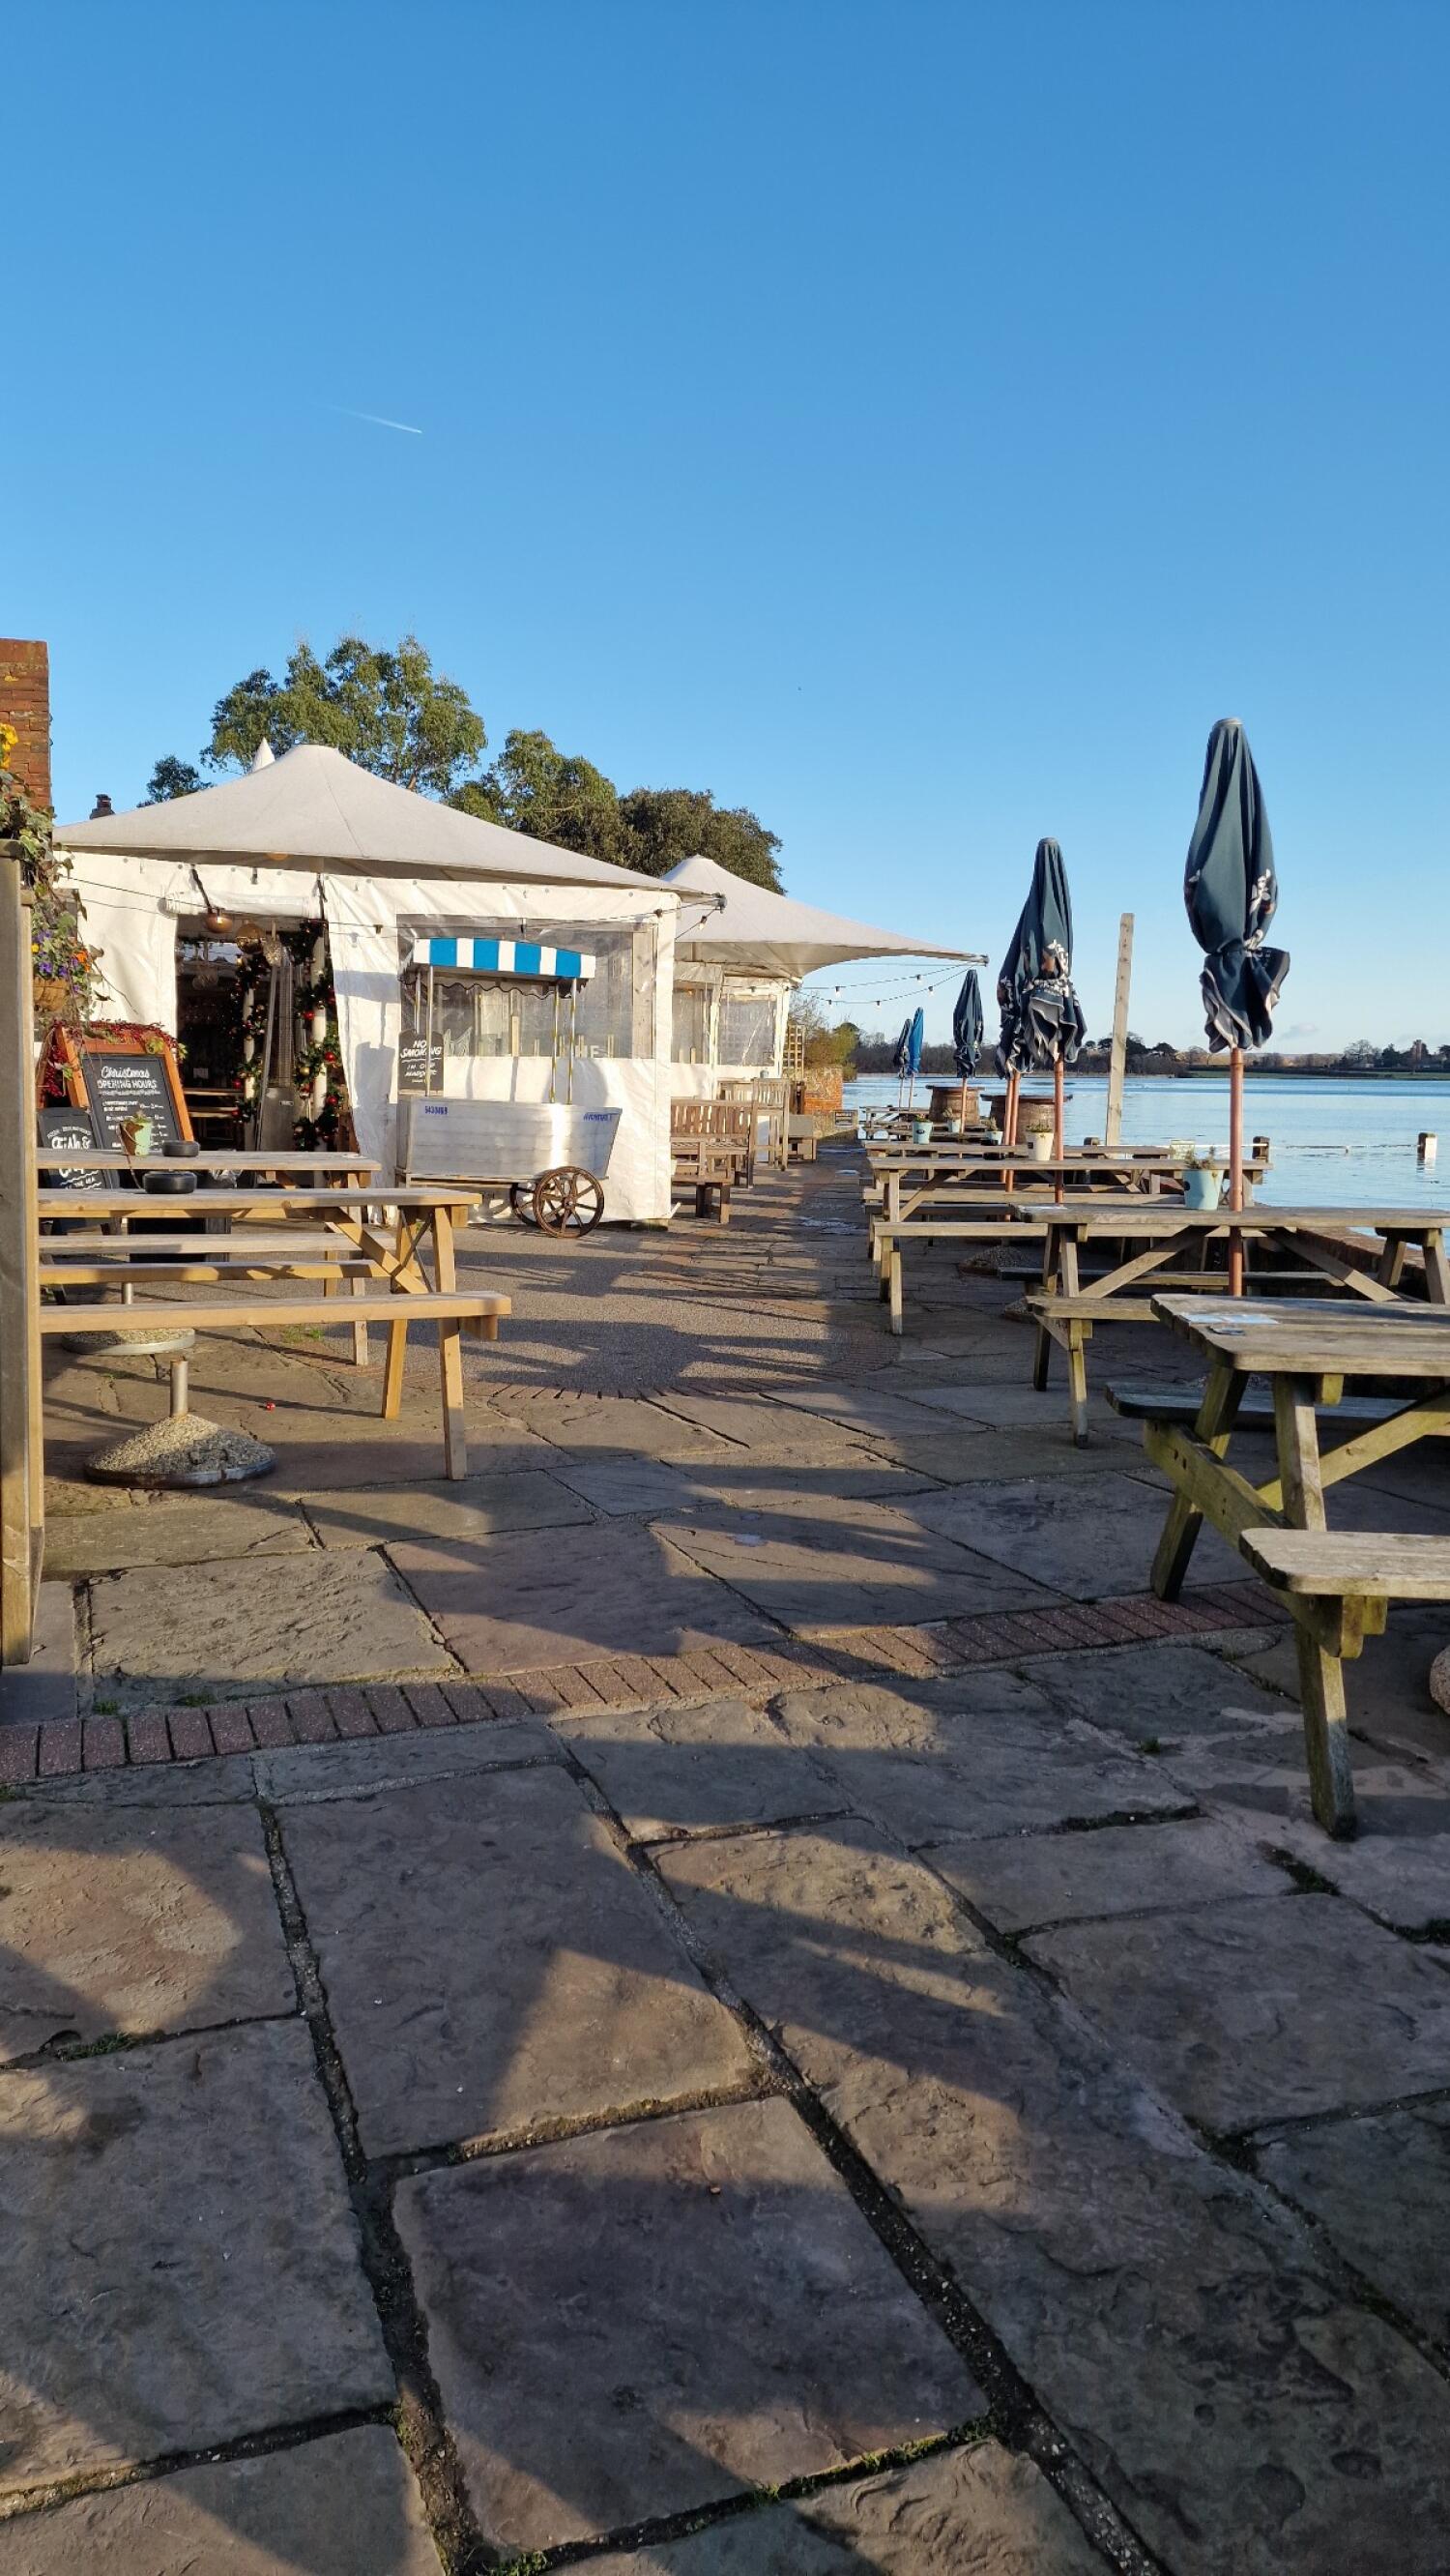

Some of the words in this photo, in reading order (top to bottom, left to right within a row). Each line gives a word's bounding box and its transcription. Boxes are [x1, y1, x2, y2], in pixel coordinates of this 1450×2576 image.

[413, 1039, 426, 1049] NO
[400, 1046, 442, 1059] SMOKNG
[101, 1066, 150, 1078] Christmas
[97, 1079, 130, 1089] OPENING
[131, 1079, 157, 1090] HOURS
